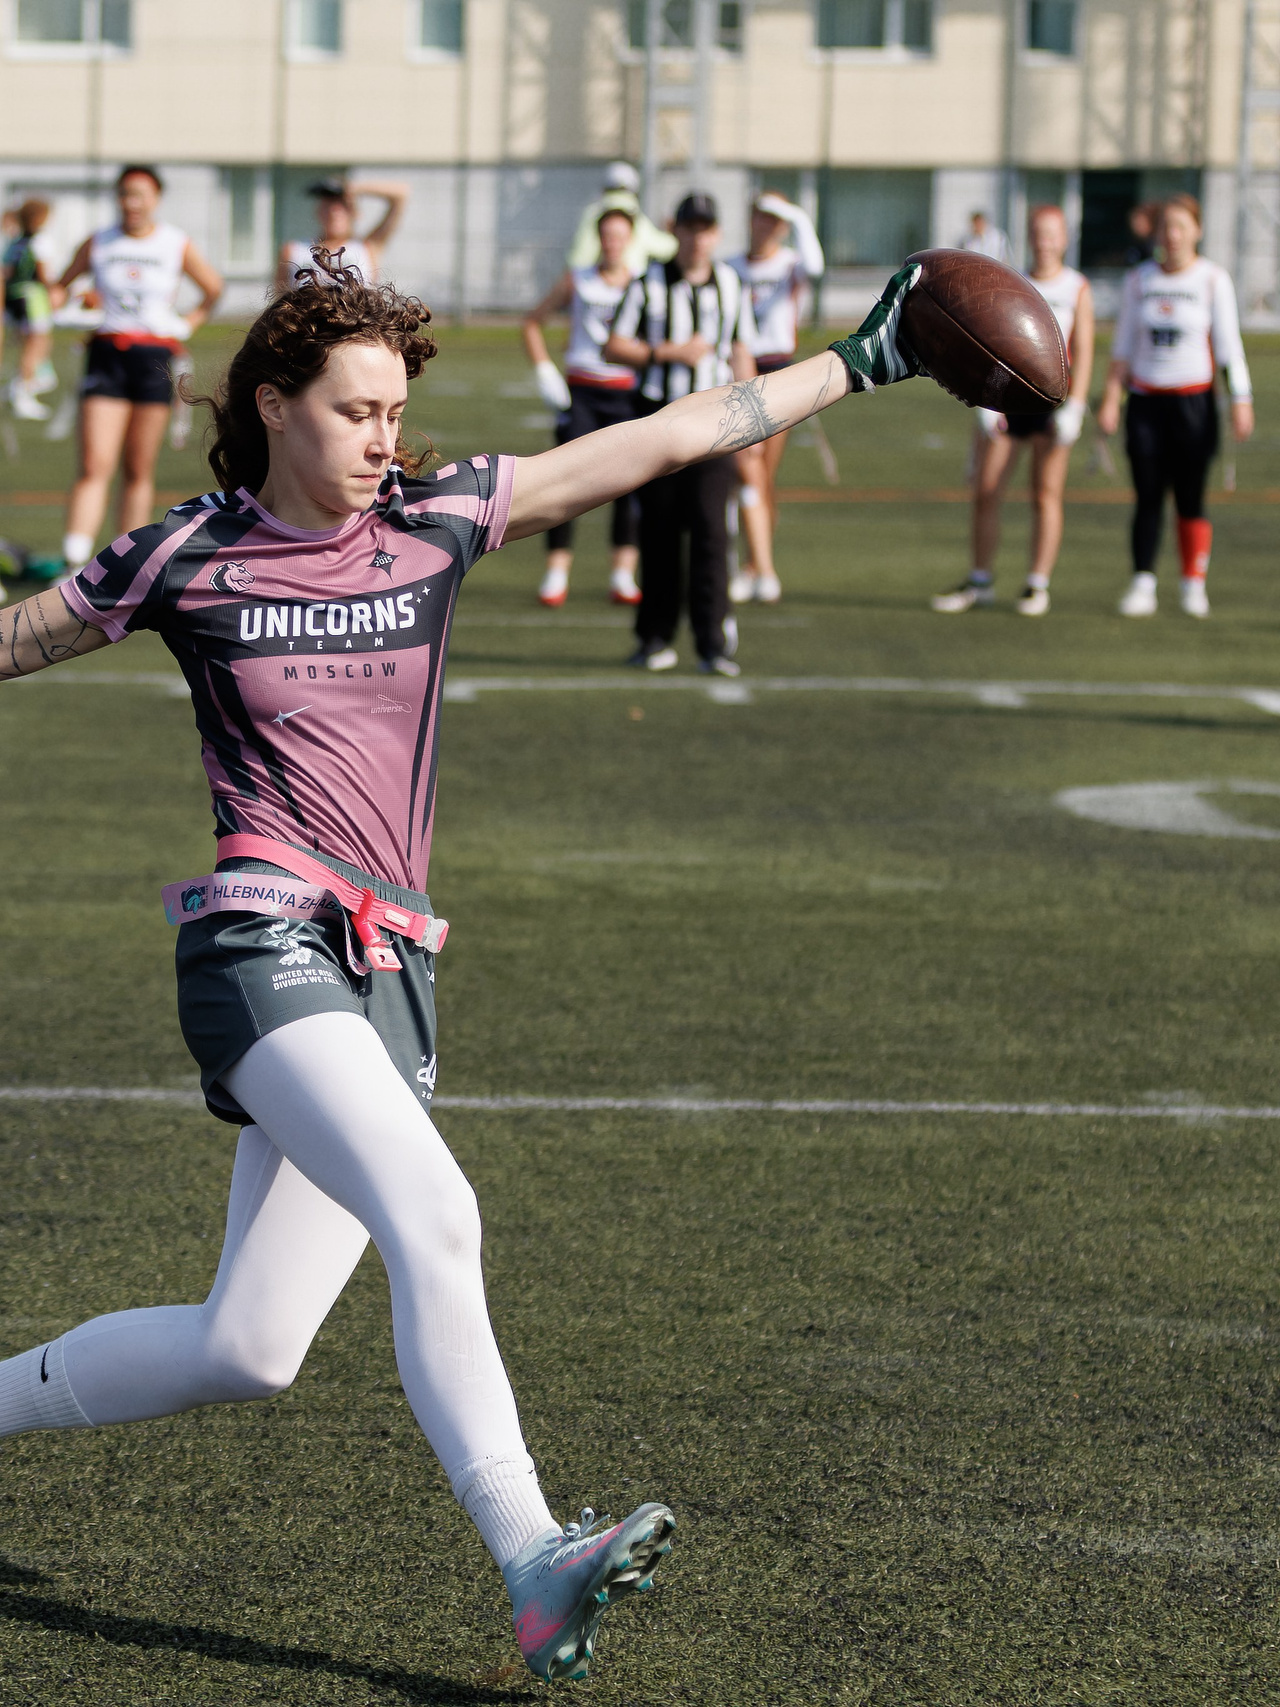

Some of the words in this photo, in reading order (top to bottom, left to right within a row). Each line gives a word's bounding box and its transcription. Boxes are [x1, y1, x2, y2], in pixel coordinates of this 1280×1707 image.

[374, 556, 393, 567] 2015
[239, 592, 417, 642] UNICORNS
[287, 637, 385, 650] TEAM
[283, 661, 397, 681] MOSCOW
[212, 885, 295, 907] HLEBNAYA
[271, 969, 303, 982] UNITED
[303, 968, 318, 976] WE
[273, 977, 308, 991] DIVIDED
[308, 976, 323, 984] WE
